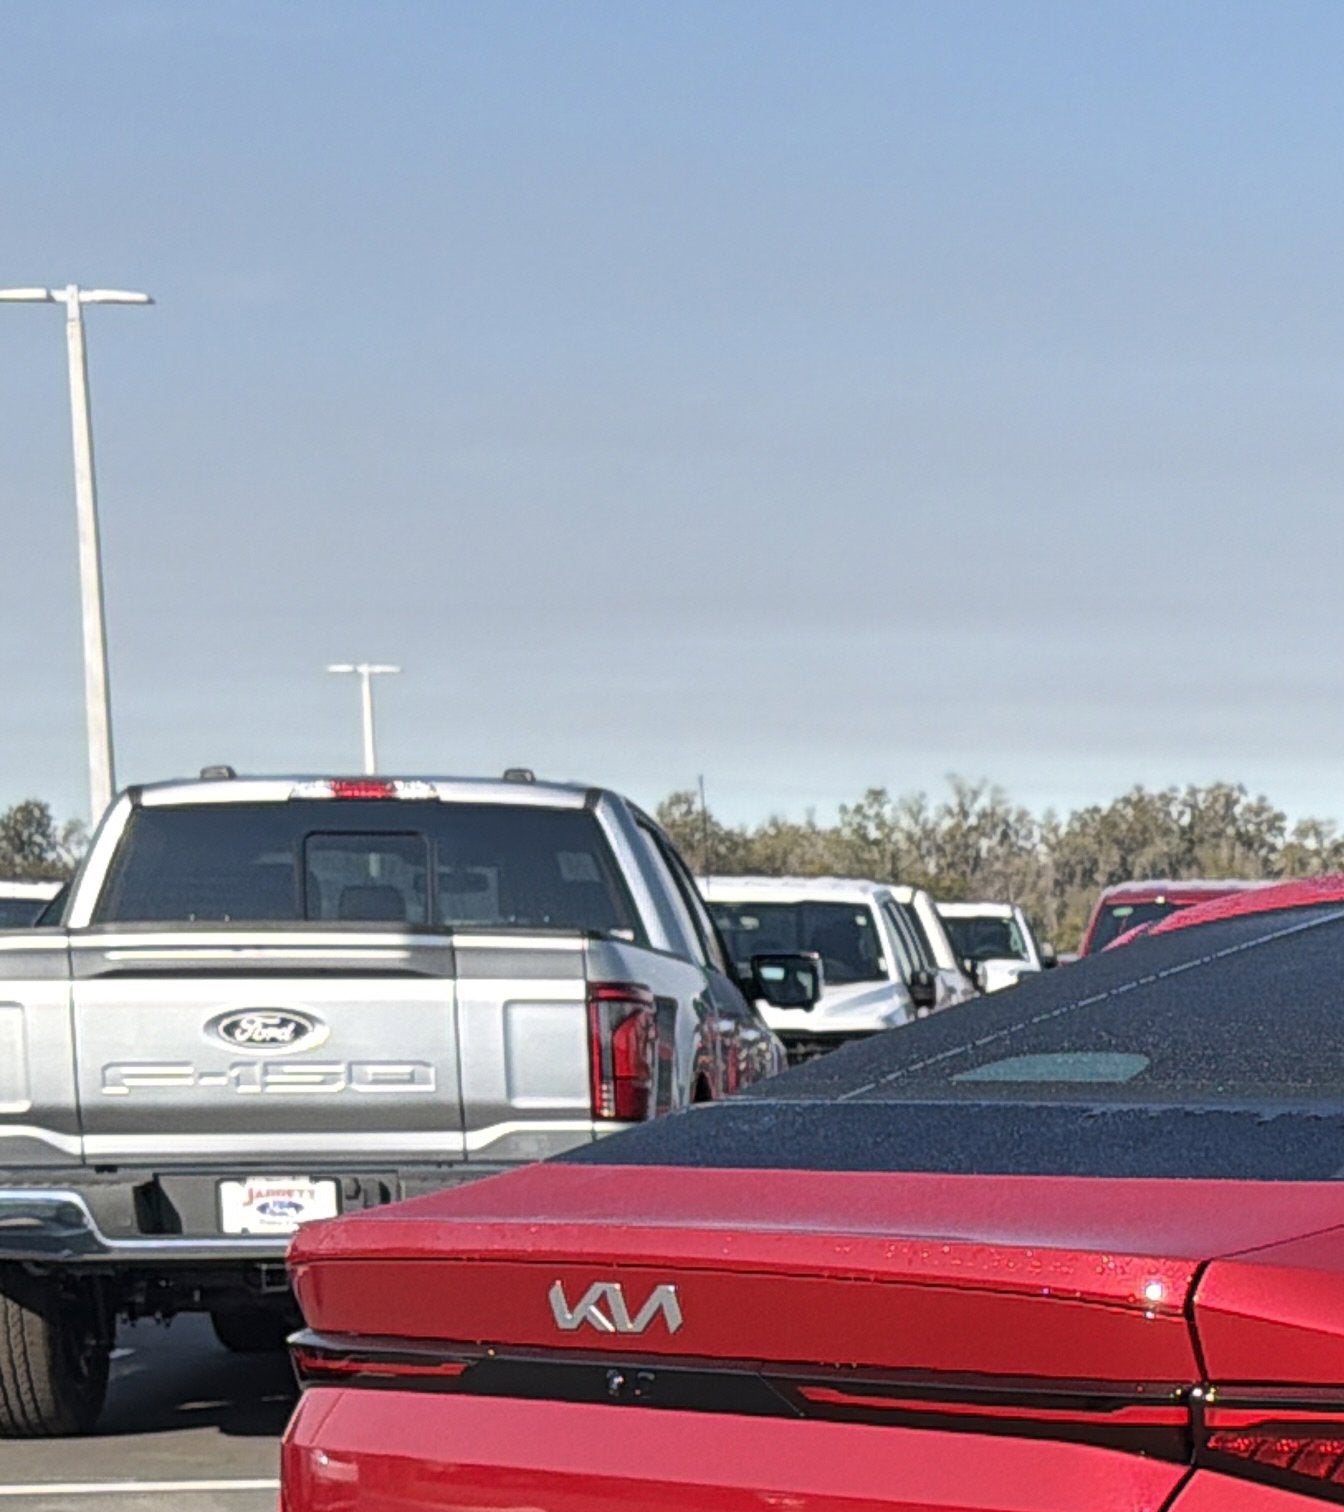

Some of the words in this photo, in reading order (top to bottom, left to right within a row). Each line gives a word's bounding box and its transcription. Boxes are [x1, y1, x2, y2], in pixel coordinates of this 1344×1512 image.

[234, 1014, 294, 1042] Ford
[101, 1060, 436, 1096] F-150
[548, 1279, 684, 1334] KIA
